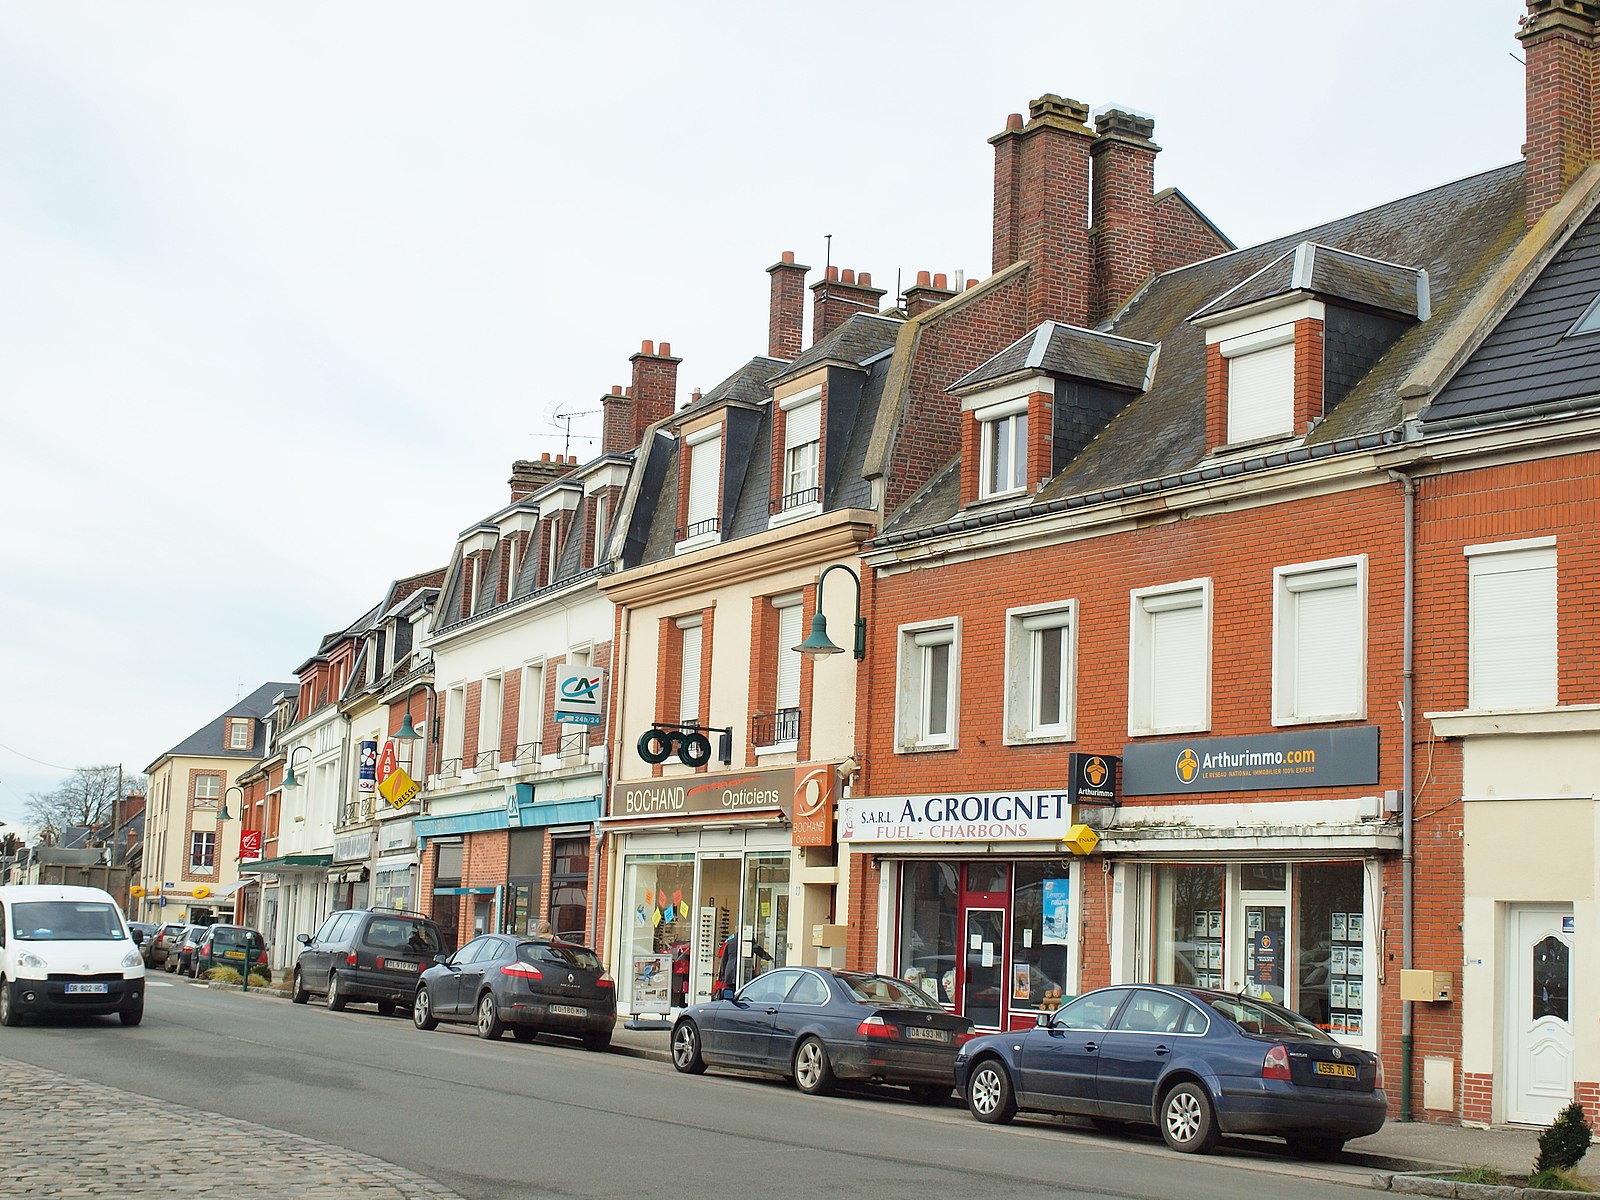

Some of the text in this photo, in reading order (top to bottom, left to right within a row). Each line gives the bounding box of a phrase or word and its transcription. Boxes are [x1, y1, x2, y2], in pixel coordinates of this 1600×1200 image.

[574, 716, 600, 724] 24h/24
[383, 748, 392, 782] TABA
[1202, 749, 1316, 769] Arthurimmo.com
[1228, 769, 1252, 777] NATIONAL
[1253, 767, 1282, 776] IMMOBILIER
[1283, 766, 1295, 775] 100%
[1295, 765, 1316, 774] EXPERT
[394, 785, 417, 807] PRESSE
[626, 786, 779, 813] BOCHAND Opticiens
[1078, 787, 1114, 798] Arthurimmo
[861, 794, 1068, 824] S.A.R.L. A.GROIGNET
[793, 821, 826, 833] BOCHAND
[876, 826, 914, 839] FUEL
[929, 823, 1028, 838] CHARBONS
[1318, 1061, 1335, 1074] 4696
[1337, 1064, 1345, 1075] ZV
